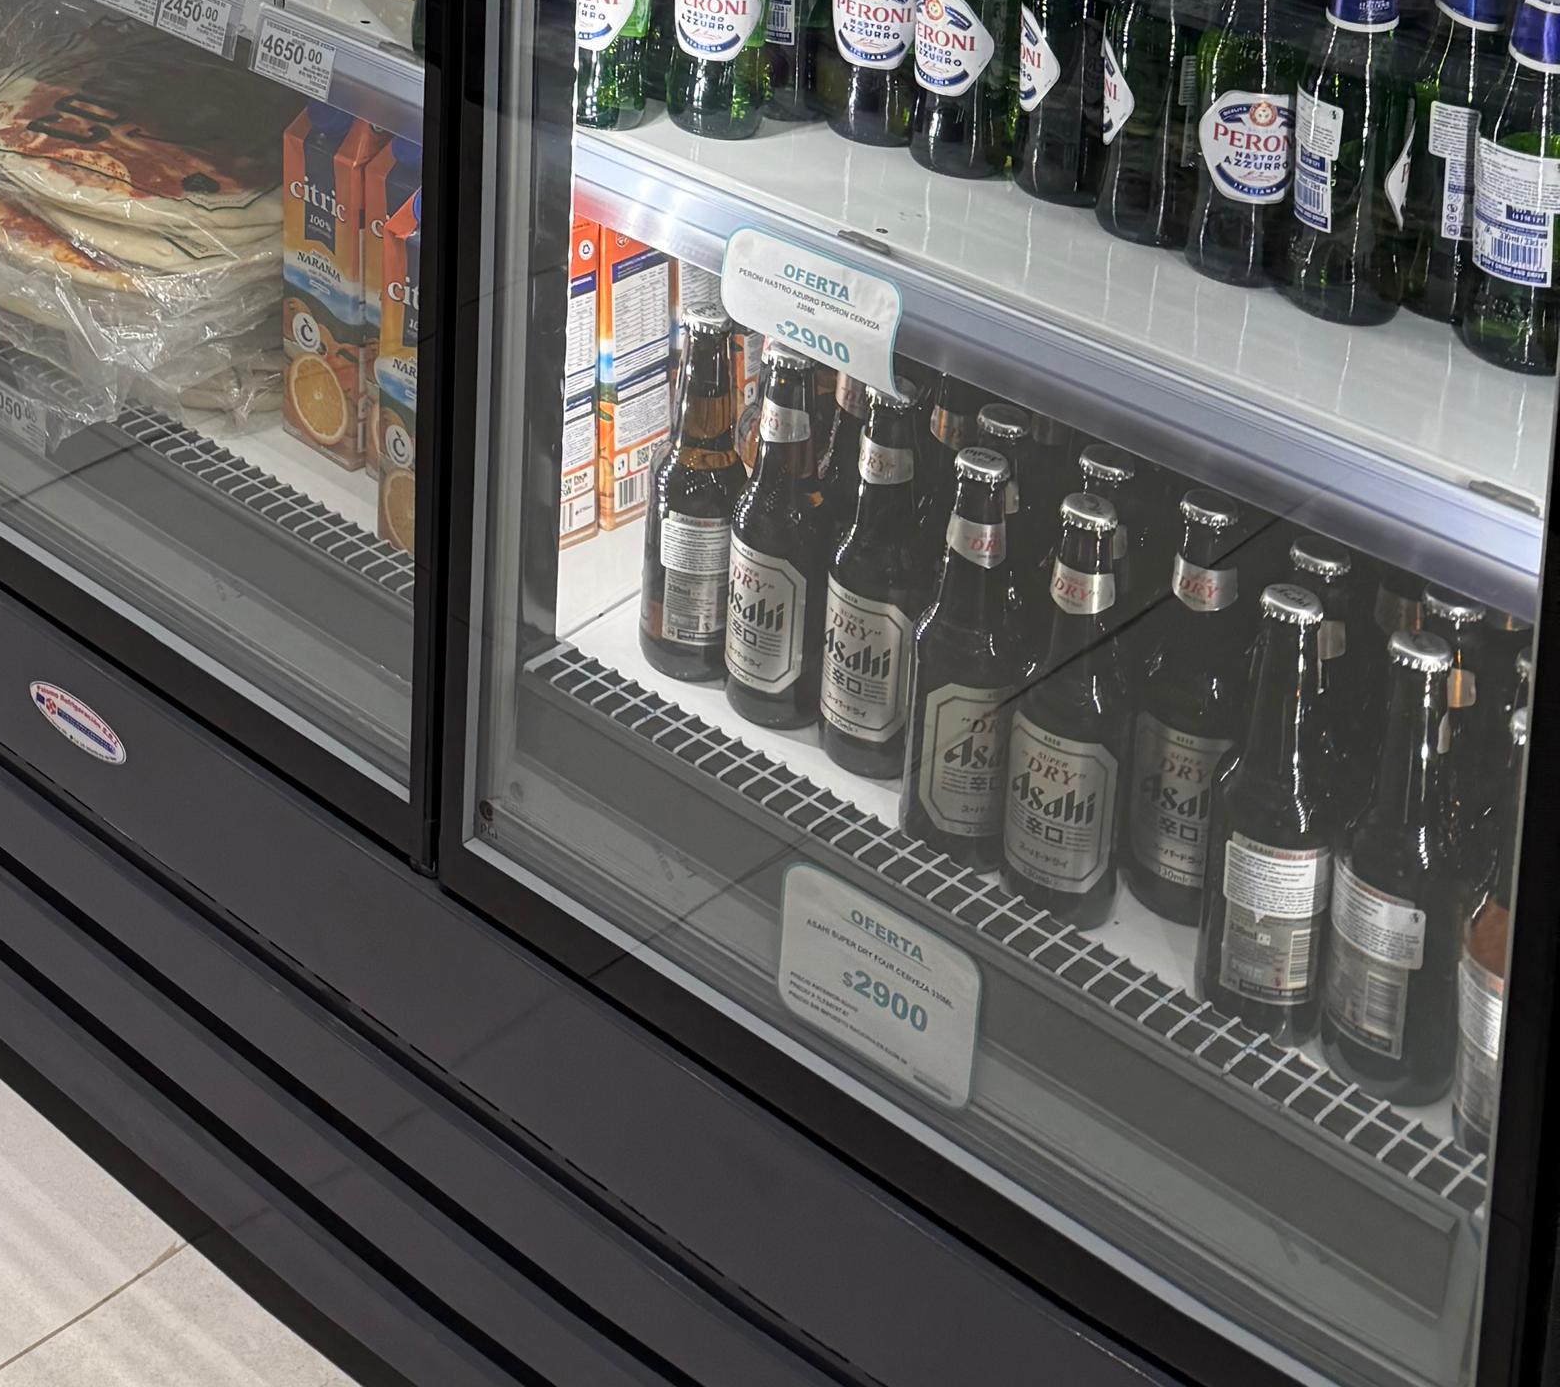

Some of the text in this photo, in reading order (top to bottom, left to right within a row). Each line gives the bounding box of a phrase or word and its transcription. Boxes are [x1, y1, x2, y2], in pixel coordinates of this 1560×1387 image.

[681, 12, 735, 32] AZZURRO
[686, 9, 727, 23] NASTRO
[850, 17, 892, 31] NASTRO
[841, 23, 901, 40] AZZURRO
[1235, 150, 1282, 162] NASTRO
[290, 176, 345, 222] citric
[309, 214, 332, 233] 100%
[296, 251, 342, 284] NARANJA
[783, 264, 850, 302] OFERTA
[738, 267, 764, 283] PERONI
[764, 279, 791, 294] NASTRO
[821, 301, 849, 319] PORRON
[850, 313, 880, 331] CERVEZA
[776, 320, 850, 364] $2900
[732, 619, 757, 647] 辛口
[825, 627, 891, 680] Asahi
[832, 668, 861, 695] 辛口
[1011, 772, 1097, 825] Asahi
[1026, 815, 1064, 843] 辛口
[1159, 816, 1199, 843] 辛口
[850, 909, 924, 962] OFERTA
[842, 970, 928, 1032] $2900
